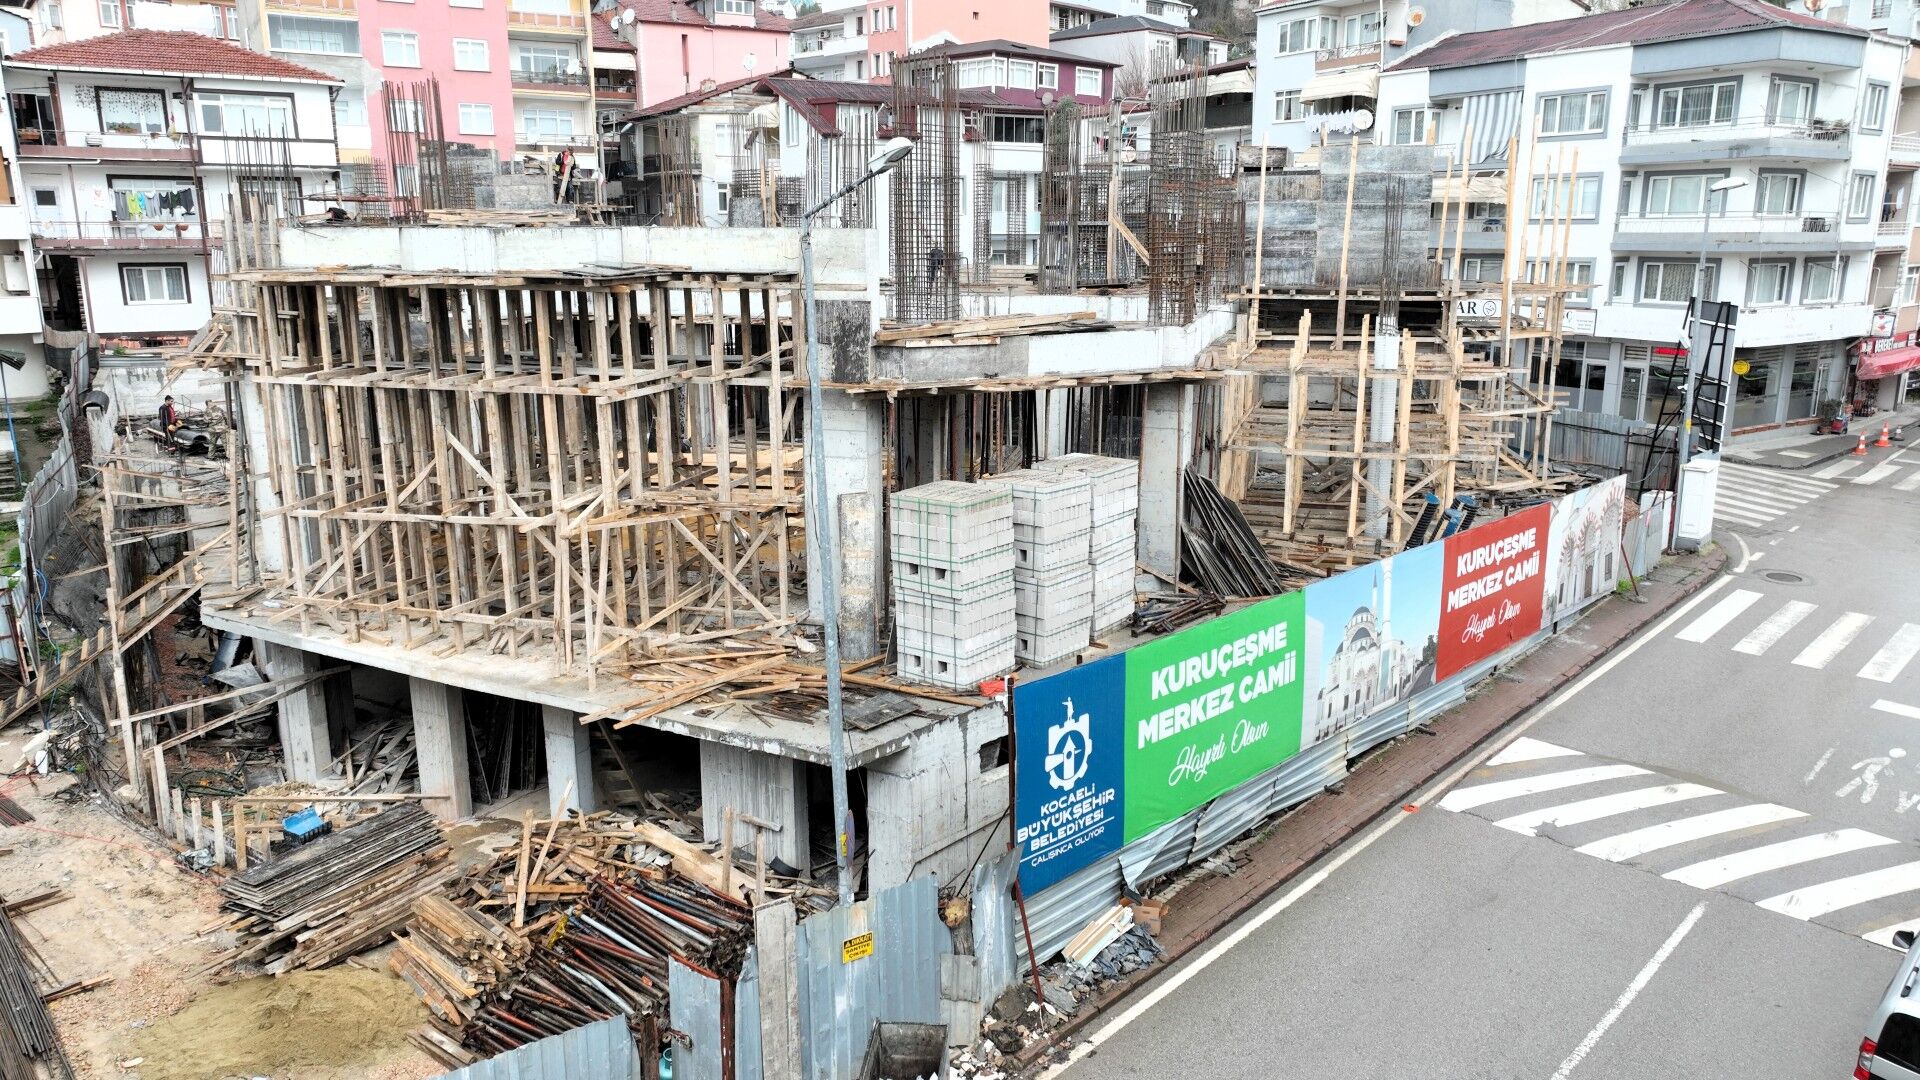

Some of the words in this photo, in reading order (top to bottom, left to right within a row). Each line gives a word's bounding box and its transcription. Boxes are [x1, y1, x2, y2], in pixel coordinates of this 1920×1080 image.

[1456, 527, 1537, 578] KURUÇEŞME
[1446, 570, 1504, 613] MERKEZ
[1505, 550, 1540, 588] CAMİİ
[1498, 599, 1521, 625] Olsun
[1151, 621, 1288, 701] KURUÇEŞME
[1137, 682, 1235, 750] MERKEZ
[1238, 650, 1297, 704] CAMİİ
[1168, 733, 1226, 786] Hayırlı
[1230, 719, 1269, 754] Olsun
[1017, 788, 1115, 844] BÜYÜKŞEHİR
[1040, 783, 1095, 817] KOCAELİ
[1030, 808, 1104, 852] BELEDİYESİ
[1031, 843, 1073, 867] ÇALIŞINCA
[1074, 826, 1105, 846] OLUYOR
